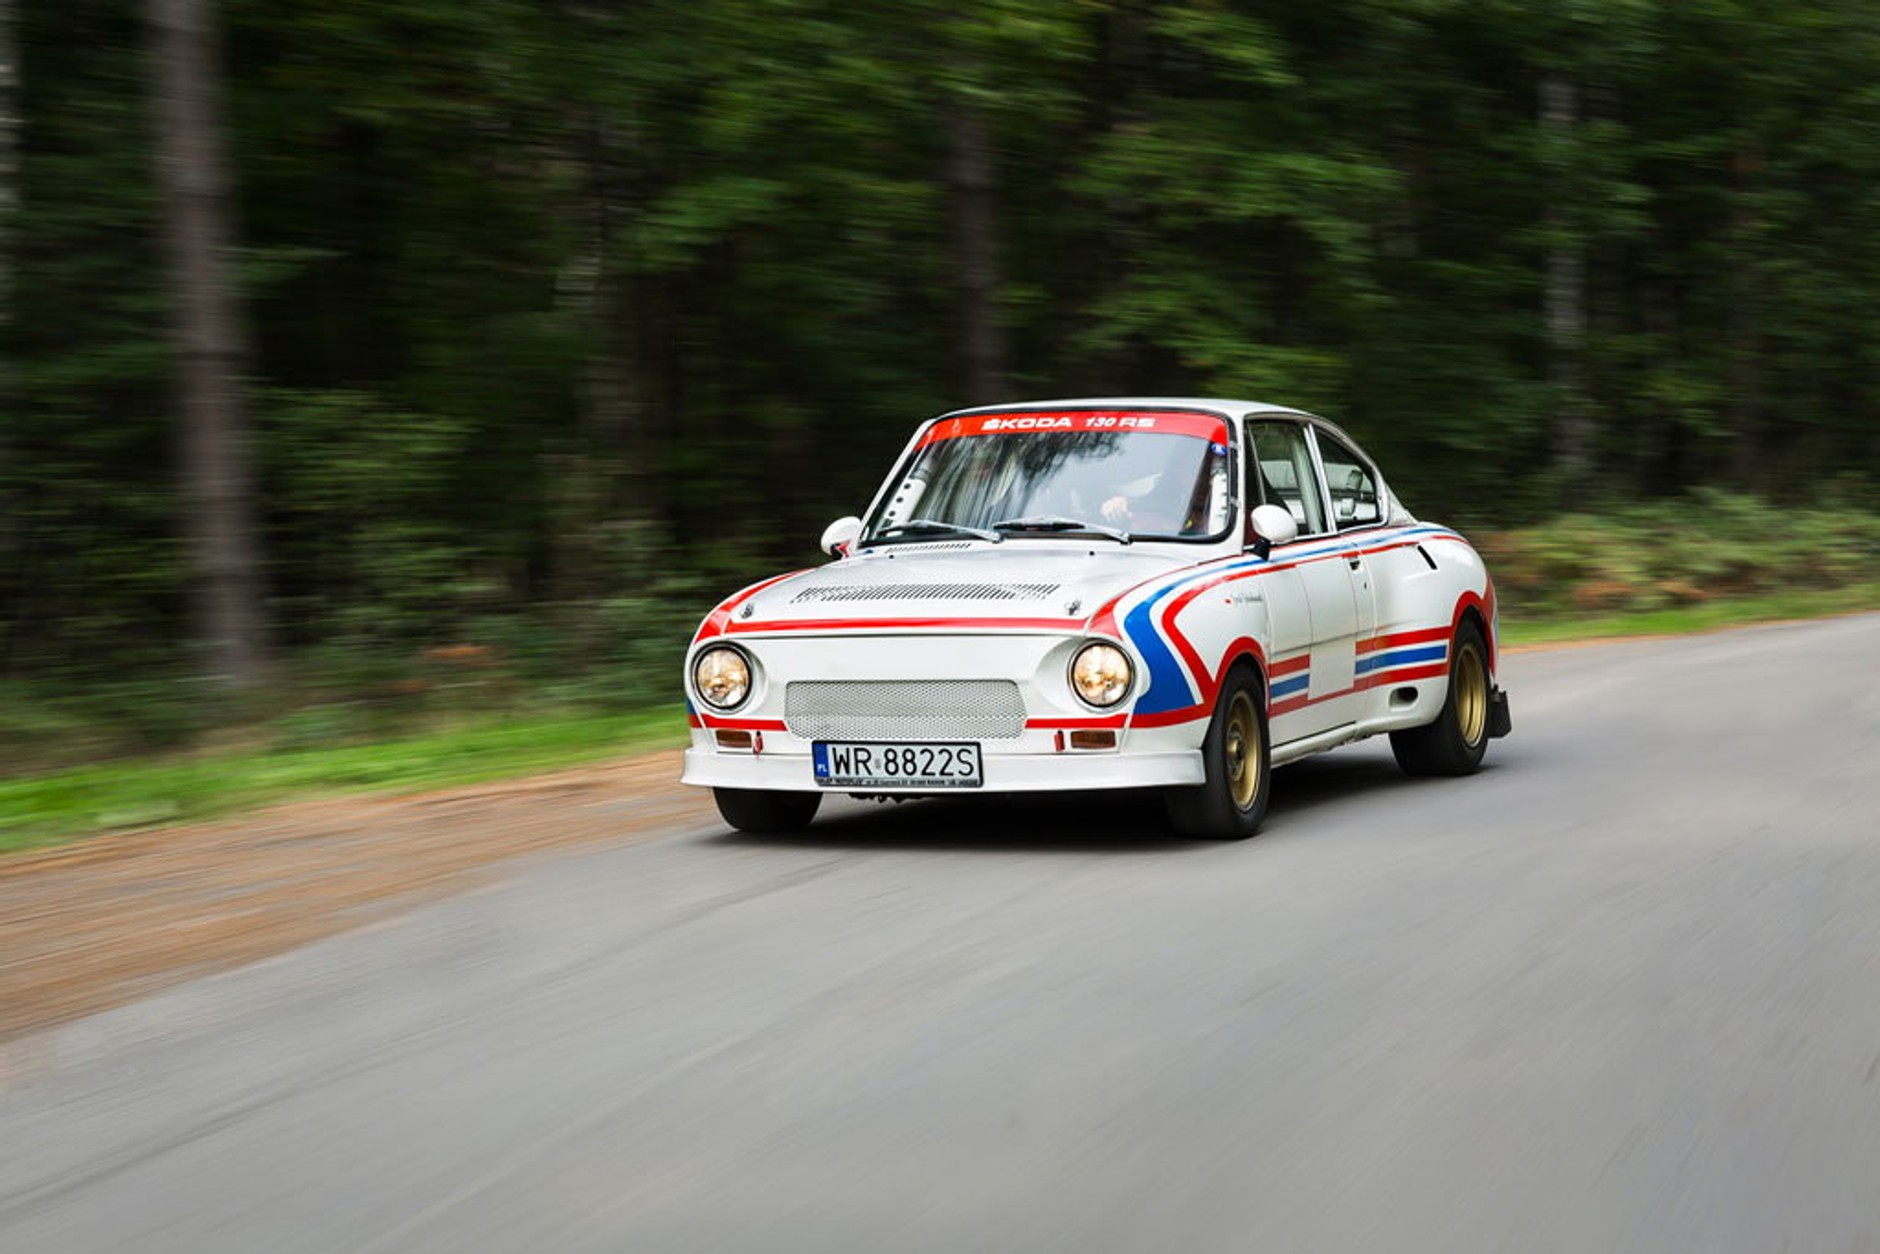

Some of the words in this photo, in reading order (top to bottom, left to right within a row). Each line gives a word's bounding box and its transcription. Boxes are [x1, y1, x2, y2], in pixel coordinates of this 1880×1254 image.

[981, 416, 1072, 430] ŠKODA
[1085, 417, 1114, 428] 130
[1118, 418, 1156, 428] RS
[817, 764, 828, 773] PL
[832, 747, 873, 776] WR
[883, 748, 974, 776] 8822S
